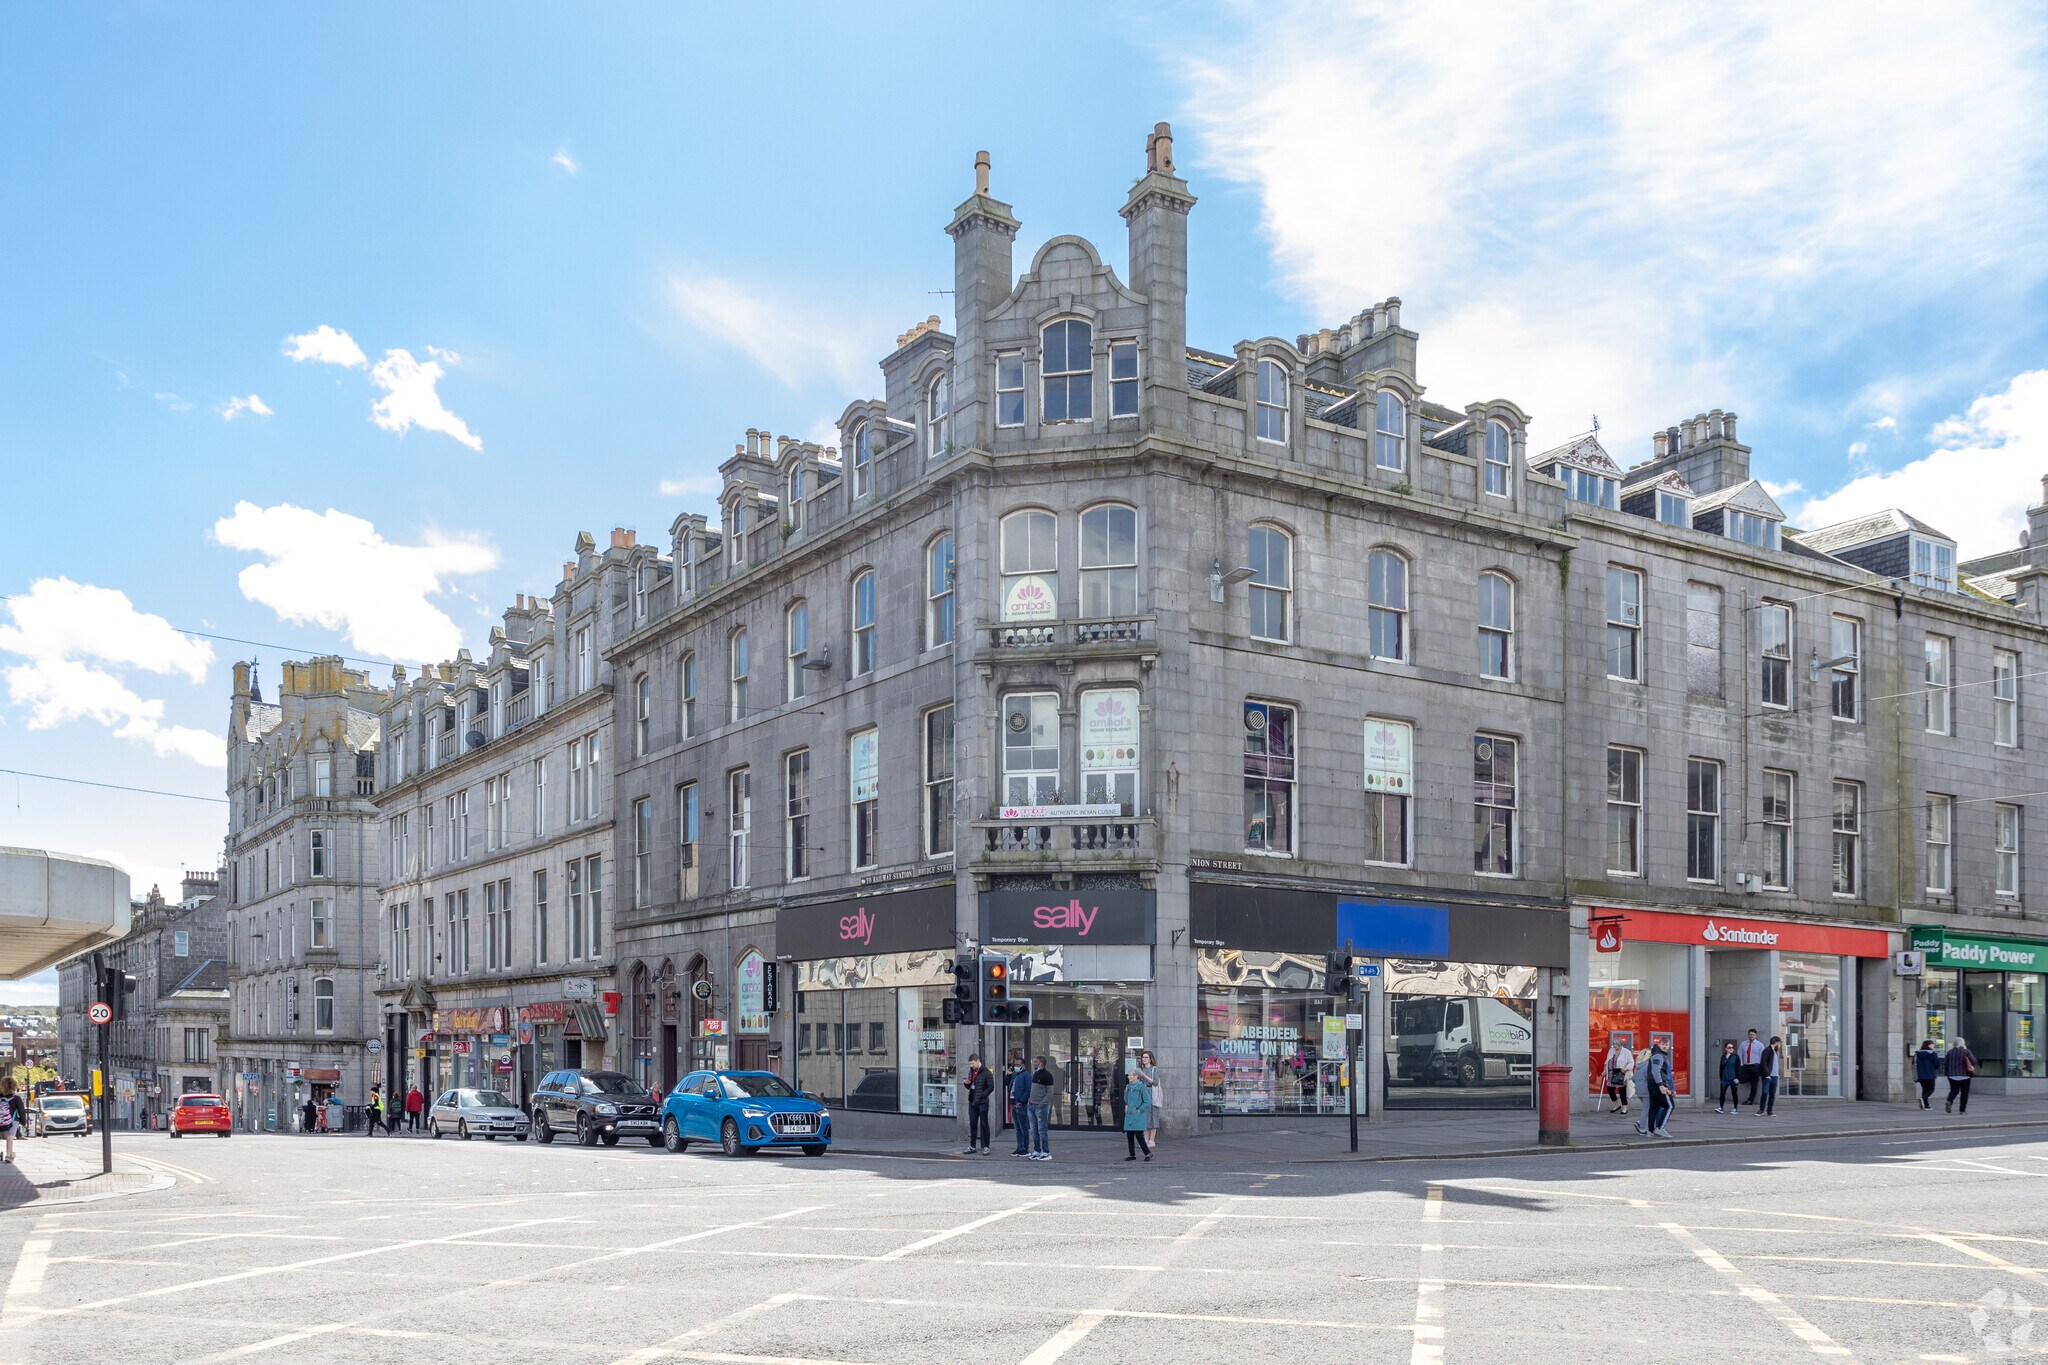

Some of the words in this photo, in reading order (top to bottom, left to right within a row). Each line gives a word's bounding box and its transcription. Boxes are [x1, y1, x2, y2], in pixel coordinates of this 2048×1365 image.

[918, 867, 935, 876] BRIDGE
[1190, 858, 1210, 867] NION
[1212, 860, 1243, 870] STREET
[866, 876, 872, 884] TO
[873, 873, 892, 883] RAILWAY
[893, 870, 913, 880] STATION
[1033, 899, 1099, 937] sally
[840, 907, 876, 946] sally
[1719, 925, 1779, 945] Santander
[1913, 940, 1940, 948] Paddy
[1942, 942, 1987, 965] Paddy
[1990, 946, 2035, 965] Power
[92, 1008, 109, 1018] 20
[1241, 1026, 1298, 1041] ABERDEEN
[1221, 1040, 1256, 1055] COME
[1260, 1041, 1277, 1056] ON
[1280, 1041, 1297, 1056] IN!
